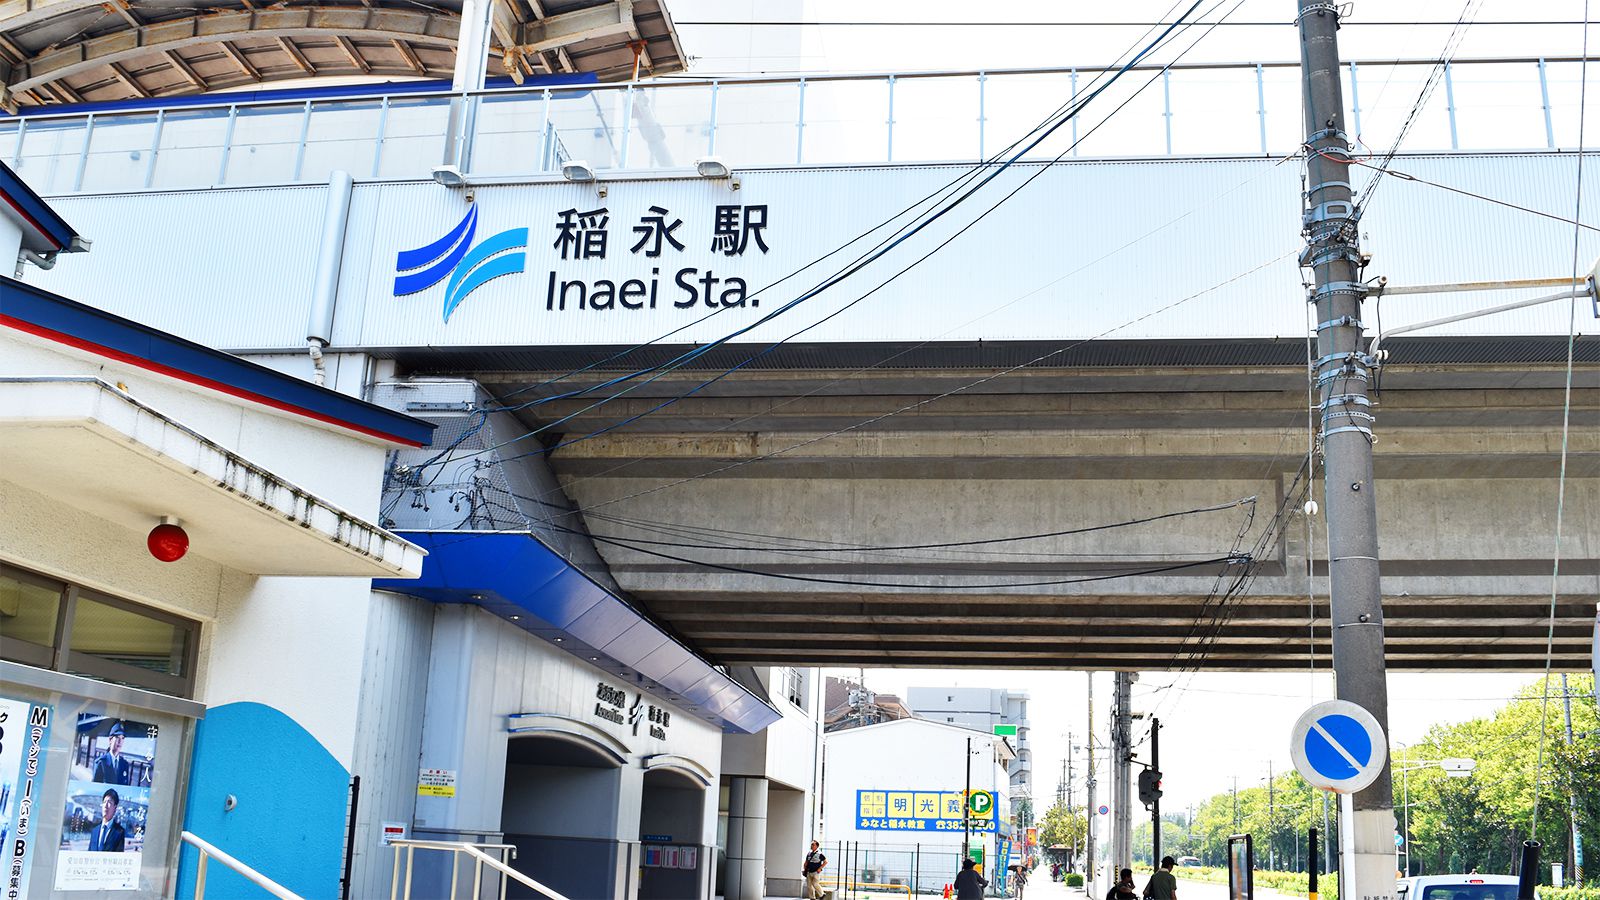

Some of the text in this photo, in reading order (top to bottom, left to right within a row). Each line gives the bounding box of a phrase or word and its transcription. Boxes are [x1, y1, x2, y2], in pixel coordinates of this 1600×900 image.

[553, 204, 770, 261] 稲永駅
[546, 267, 760, 311] Inaei Sta.
[894, 798, 960, 814] 明光義
[975, 794, 989, 811] P
